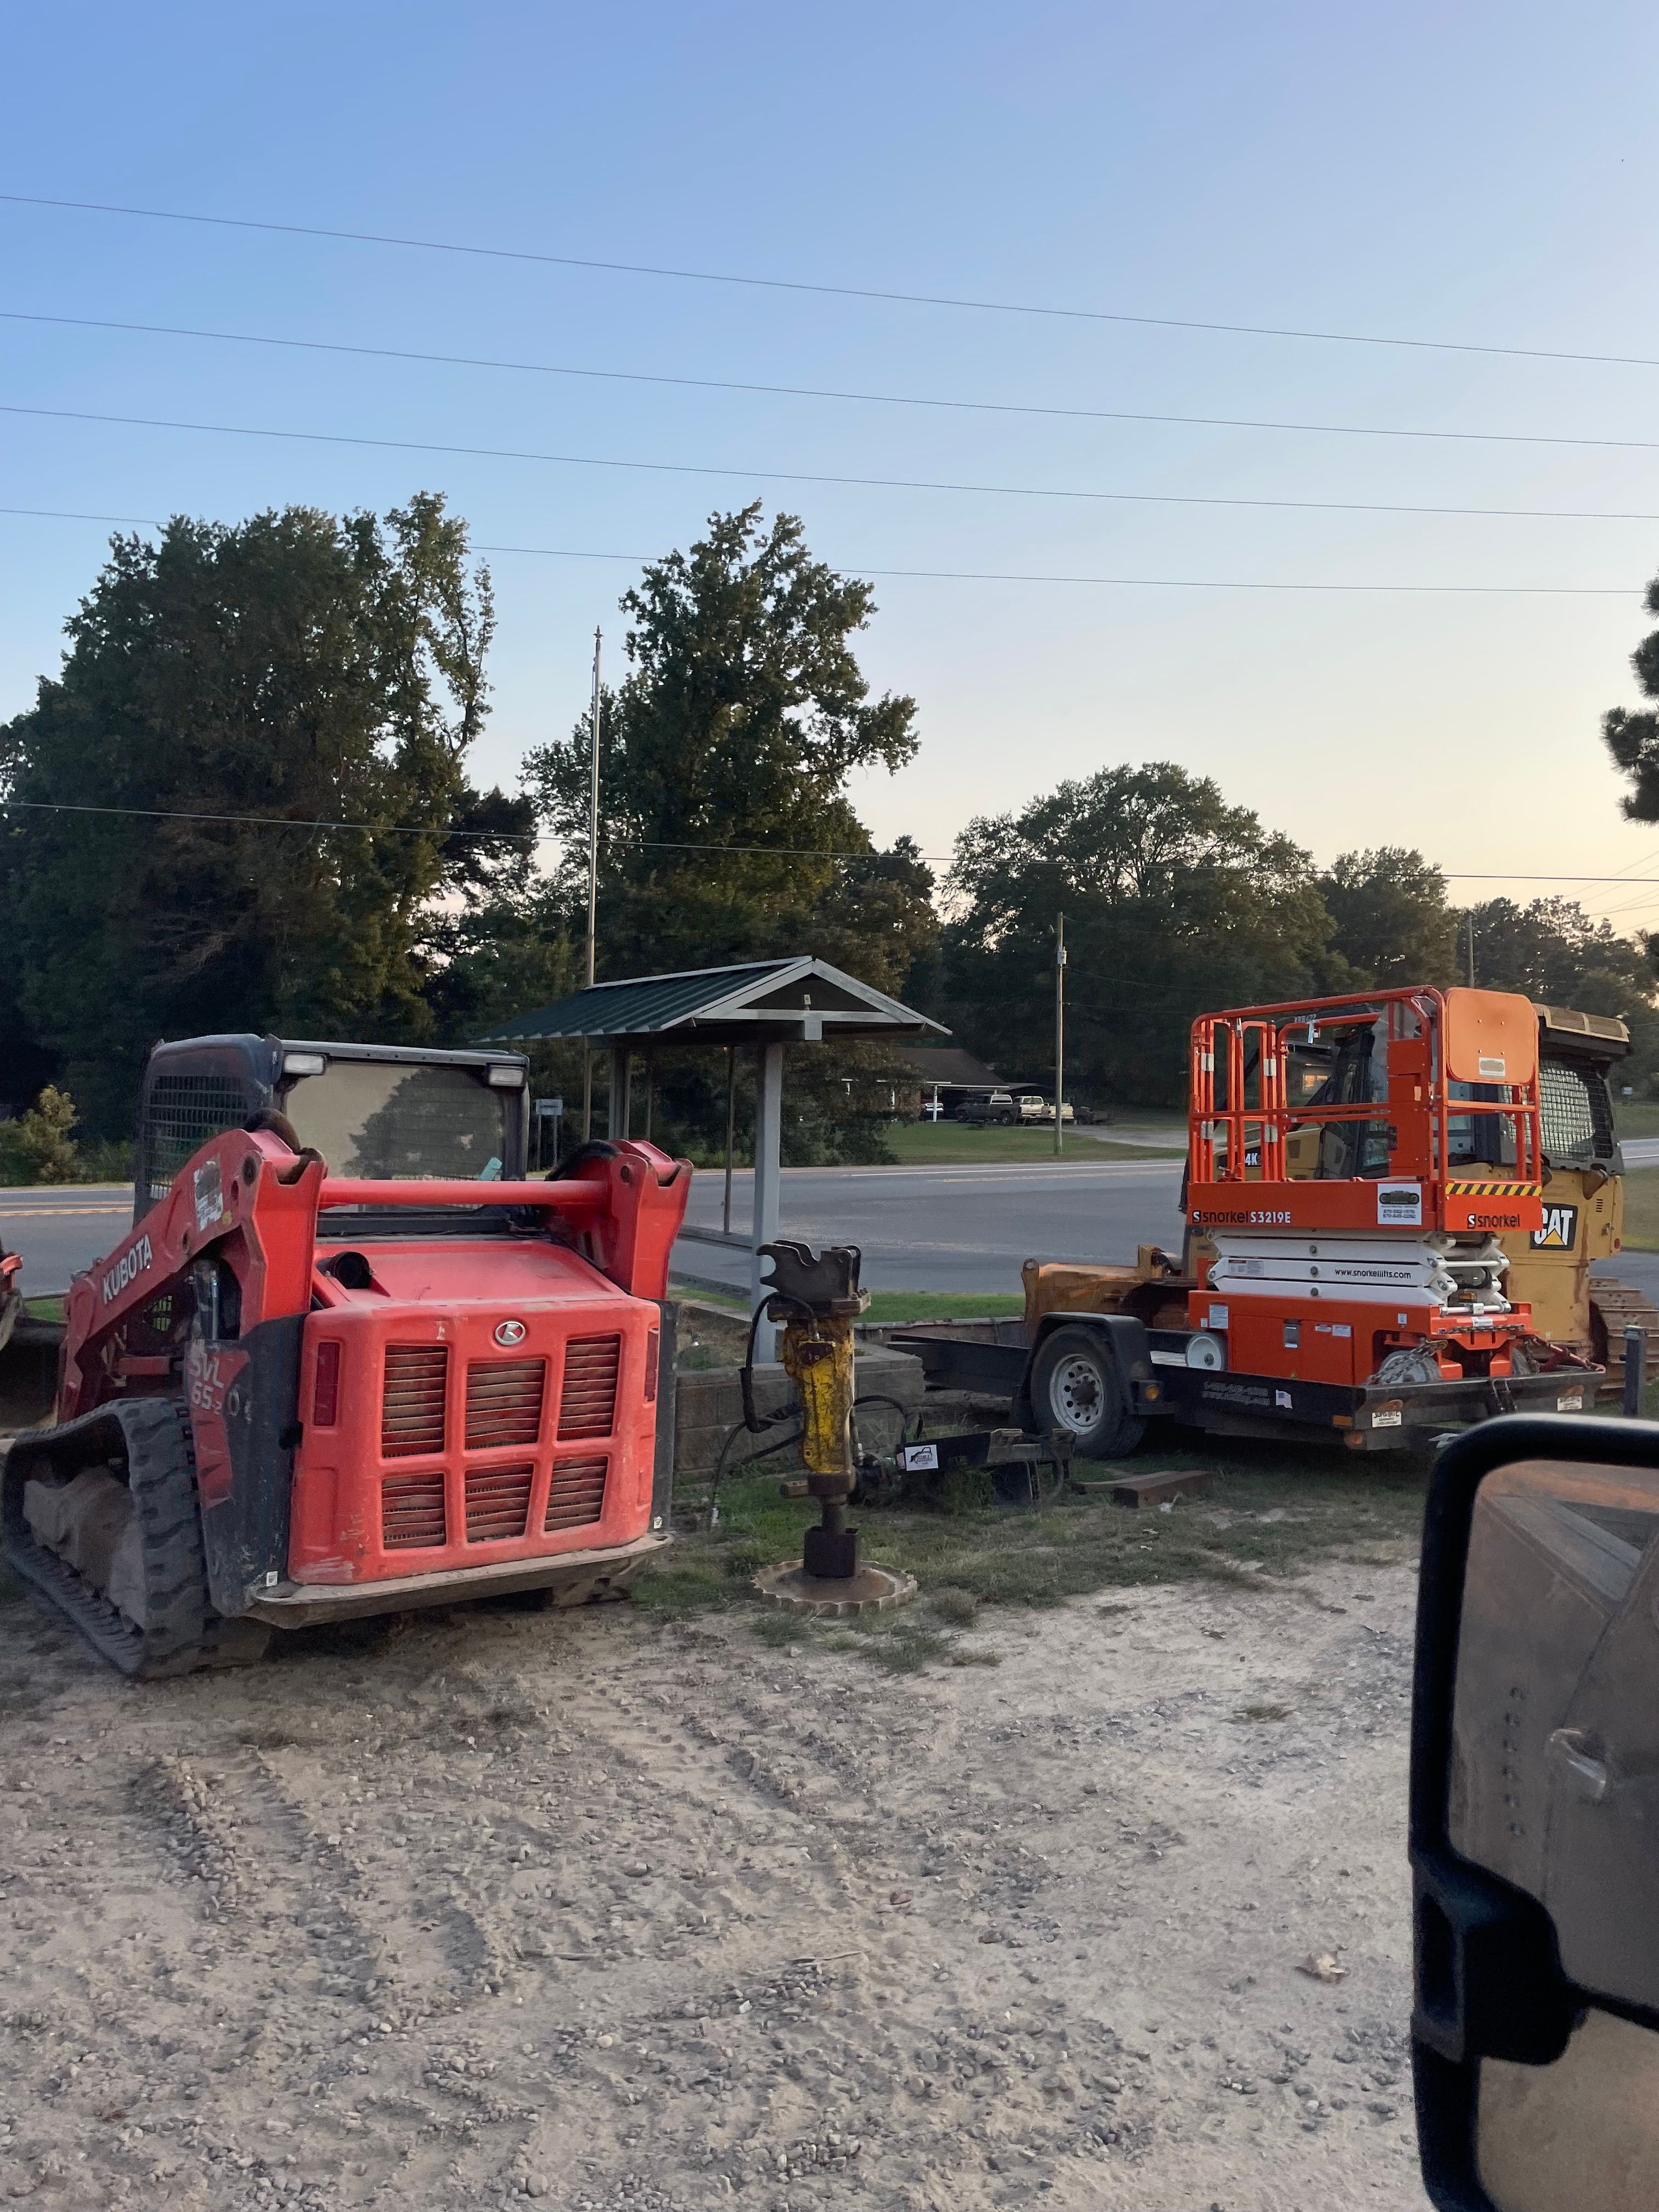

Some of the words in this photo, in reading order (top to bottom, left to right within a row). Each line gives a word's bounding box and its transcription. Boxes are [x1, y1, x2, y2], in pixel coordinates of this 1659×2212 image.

[1203, 1211, 1248, 1223] snorkel
[1250, 1211, 1291, 1223] S3219E
[1477, 1214, 1520, 1228] snorkel
[1534, 1207, 1573, 1245] CAT
[104, 1234, 153, 1305] KUBOTA
[187, 1352, 224, 1389] SVL
